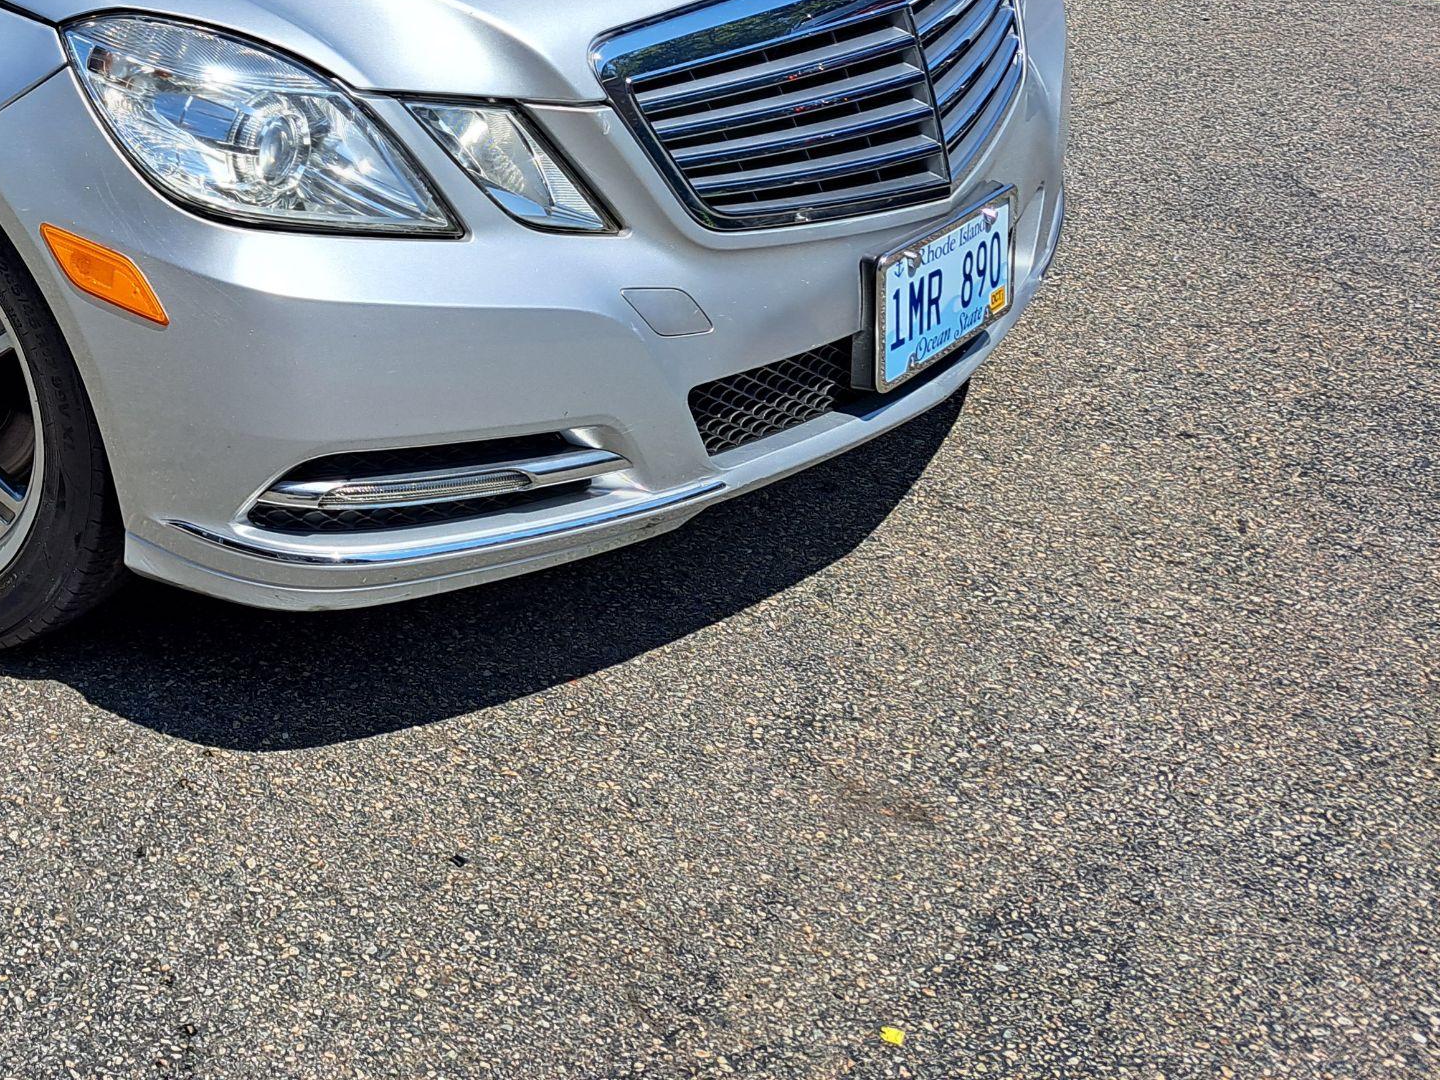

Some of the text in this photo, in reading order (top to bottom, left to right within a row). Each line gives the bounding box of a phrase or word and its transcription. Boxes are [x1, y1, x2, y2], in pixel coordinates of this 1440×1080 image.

[920, 234, 956, 266] Rhode
[891, 232, 1001, 350] 1MR 890
[915, 306, 983, 361] Ocean State
